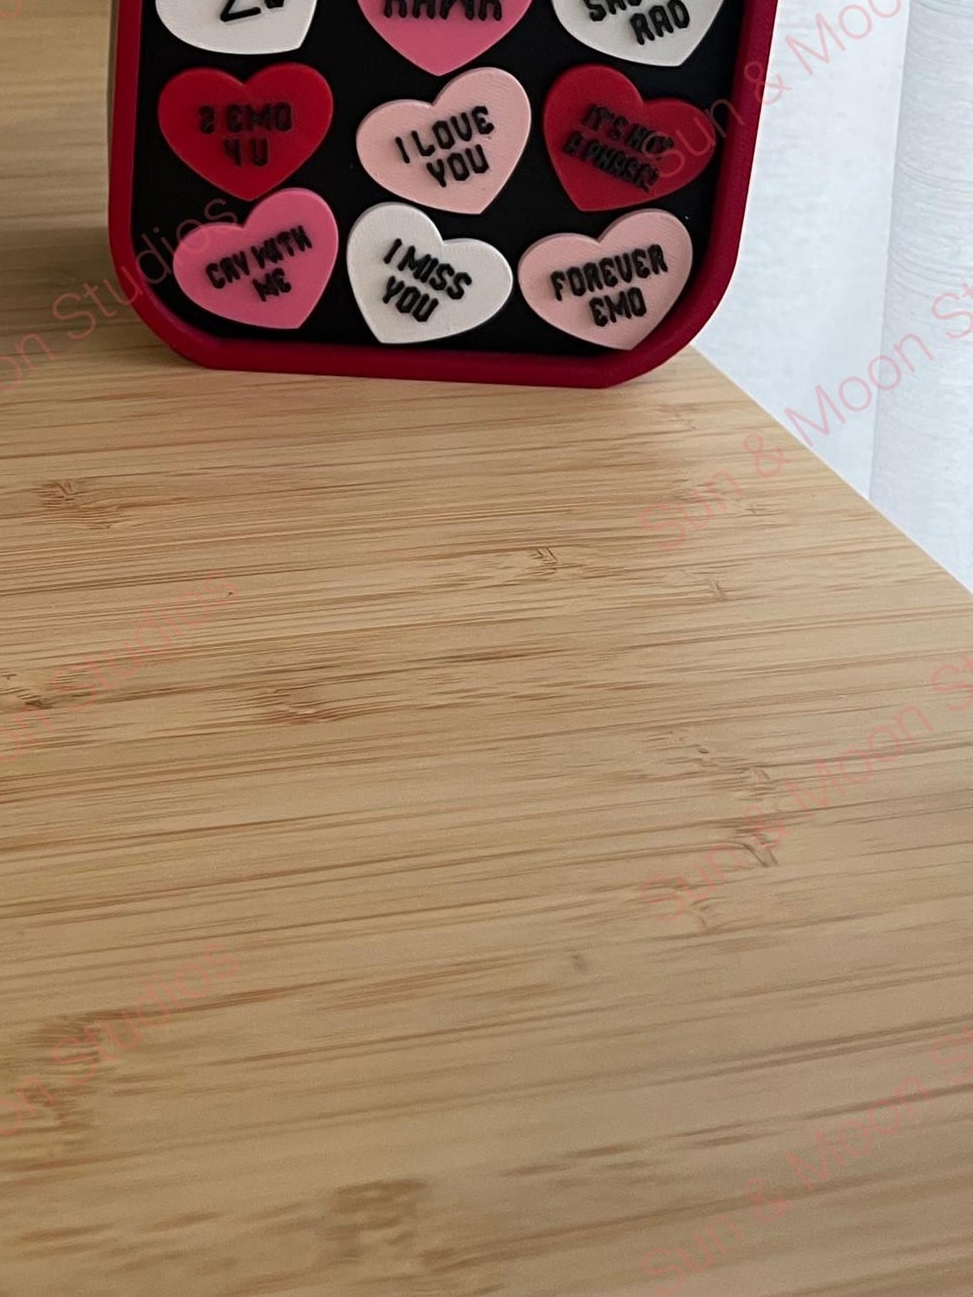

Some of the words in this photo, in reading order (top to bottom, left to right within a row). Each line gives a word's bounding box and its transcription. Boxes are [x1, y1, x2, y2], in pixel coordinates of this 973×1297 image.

[228, 101, 293, 133] EMO
[395, 136, 411, 165] I
[411, 105, 495, 158] LOVE
[251, 138, 269, 167] U
[426, 144, 490, 188] YOU
[251, 225, 313, 269] WITH
[252, 268, 292, 303] ME
[383, 238, 404, 265] I
[397, 245, 473, 301] MISS
[550, 244, 669, 302] FOREVER
[382, 275, 440, 323] YOU
[588, 286, 648, 328] EMO
